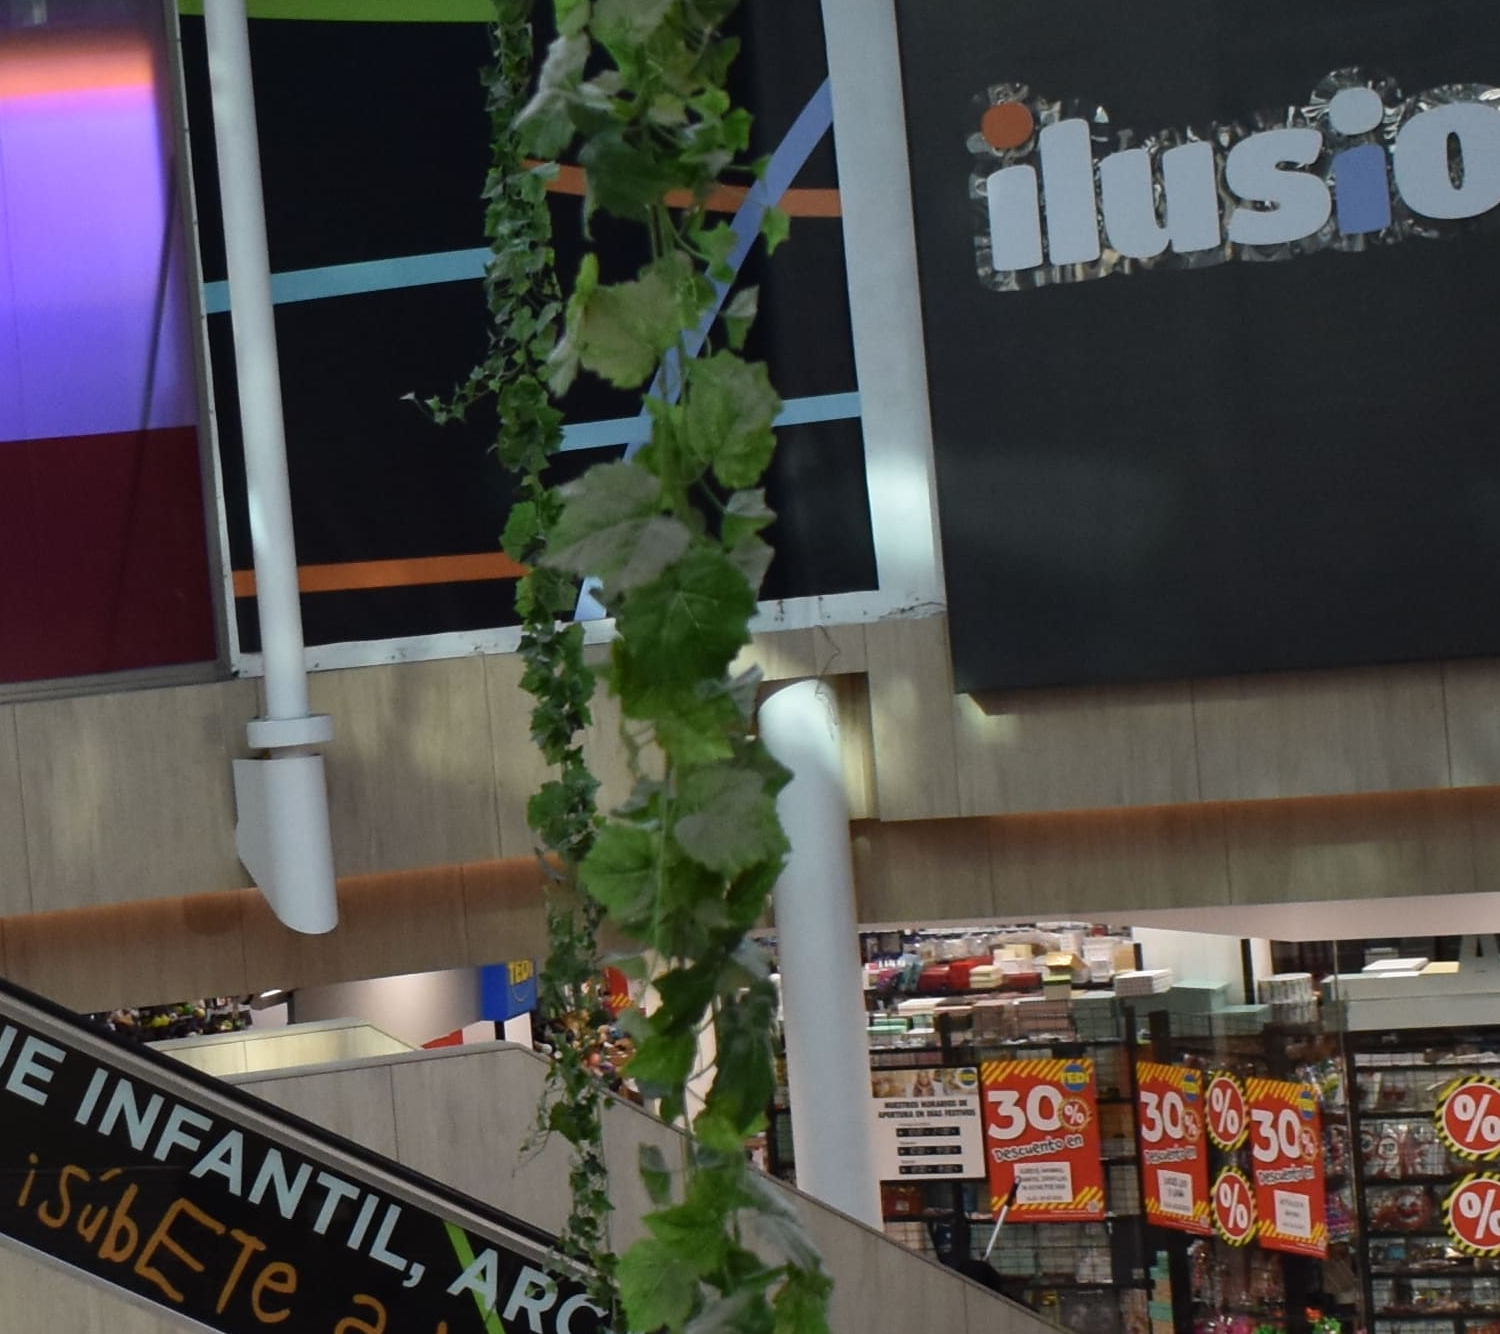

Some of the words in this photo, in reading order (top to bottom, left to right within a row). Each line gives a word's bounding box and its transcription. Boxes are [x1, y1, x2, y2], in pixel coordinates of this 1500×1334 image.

[74, 1067, 425, 1289] INFANTIL,
[994, 1138, 1064, 1162] Descuento
[1066, 1135, 1084, 1148] en
